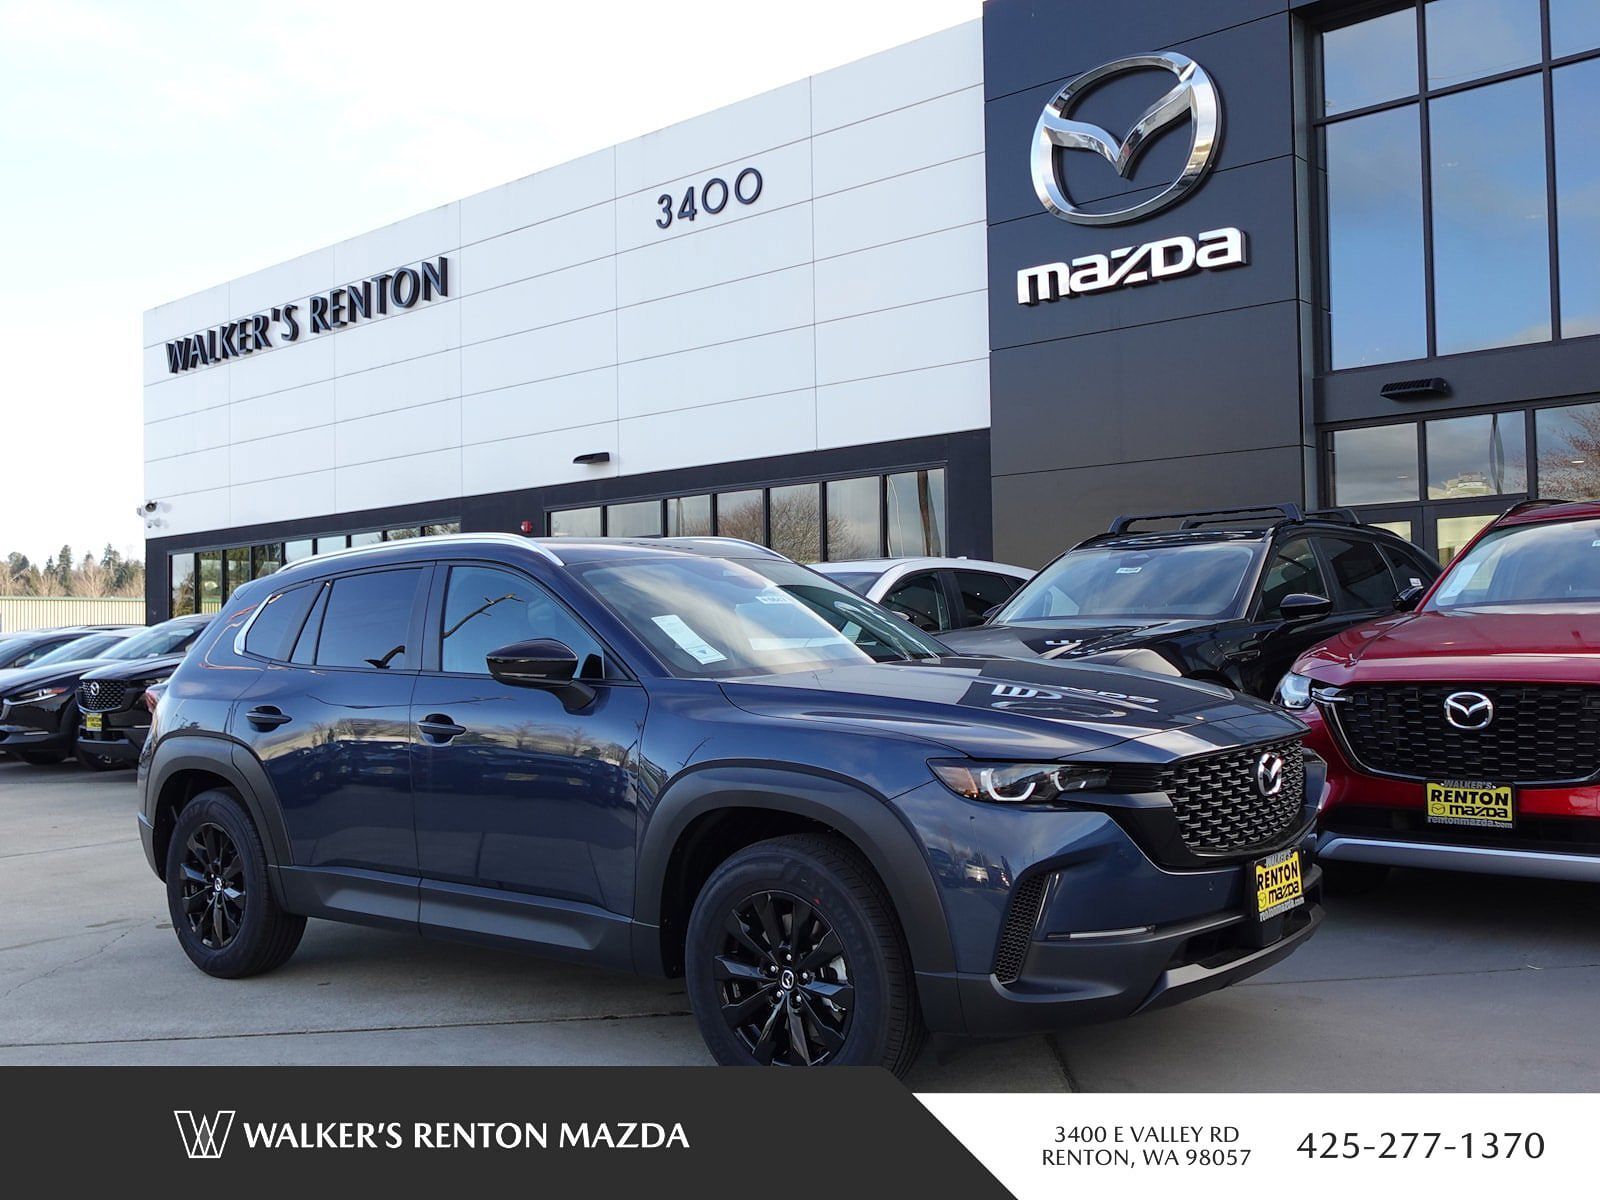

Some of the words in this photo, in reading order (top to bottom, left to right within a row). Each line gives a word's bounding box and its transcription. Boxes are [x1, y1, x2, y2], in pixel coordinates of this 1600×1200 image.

[656, 168, 763, 229] 3400
[1017, 227, 1244, 305] mazda
[166, 304, 300, 374] WALKER'S
[310, 256, 449, 334] RENTON
[1431, 789, 1509, 806] RENTON
[1449, 804, 1508, 818] mazda
[1427, 815, 1513, 829] rentonmazda.com
[1257, 860, 1299, 892] RENTON
